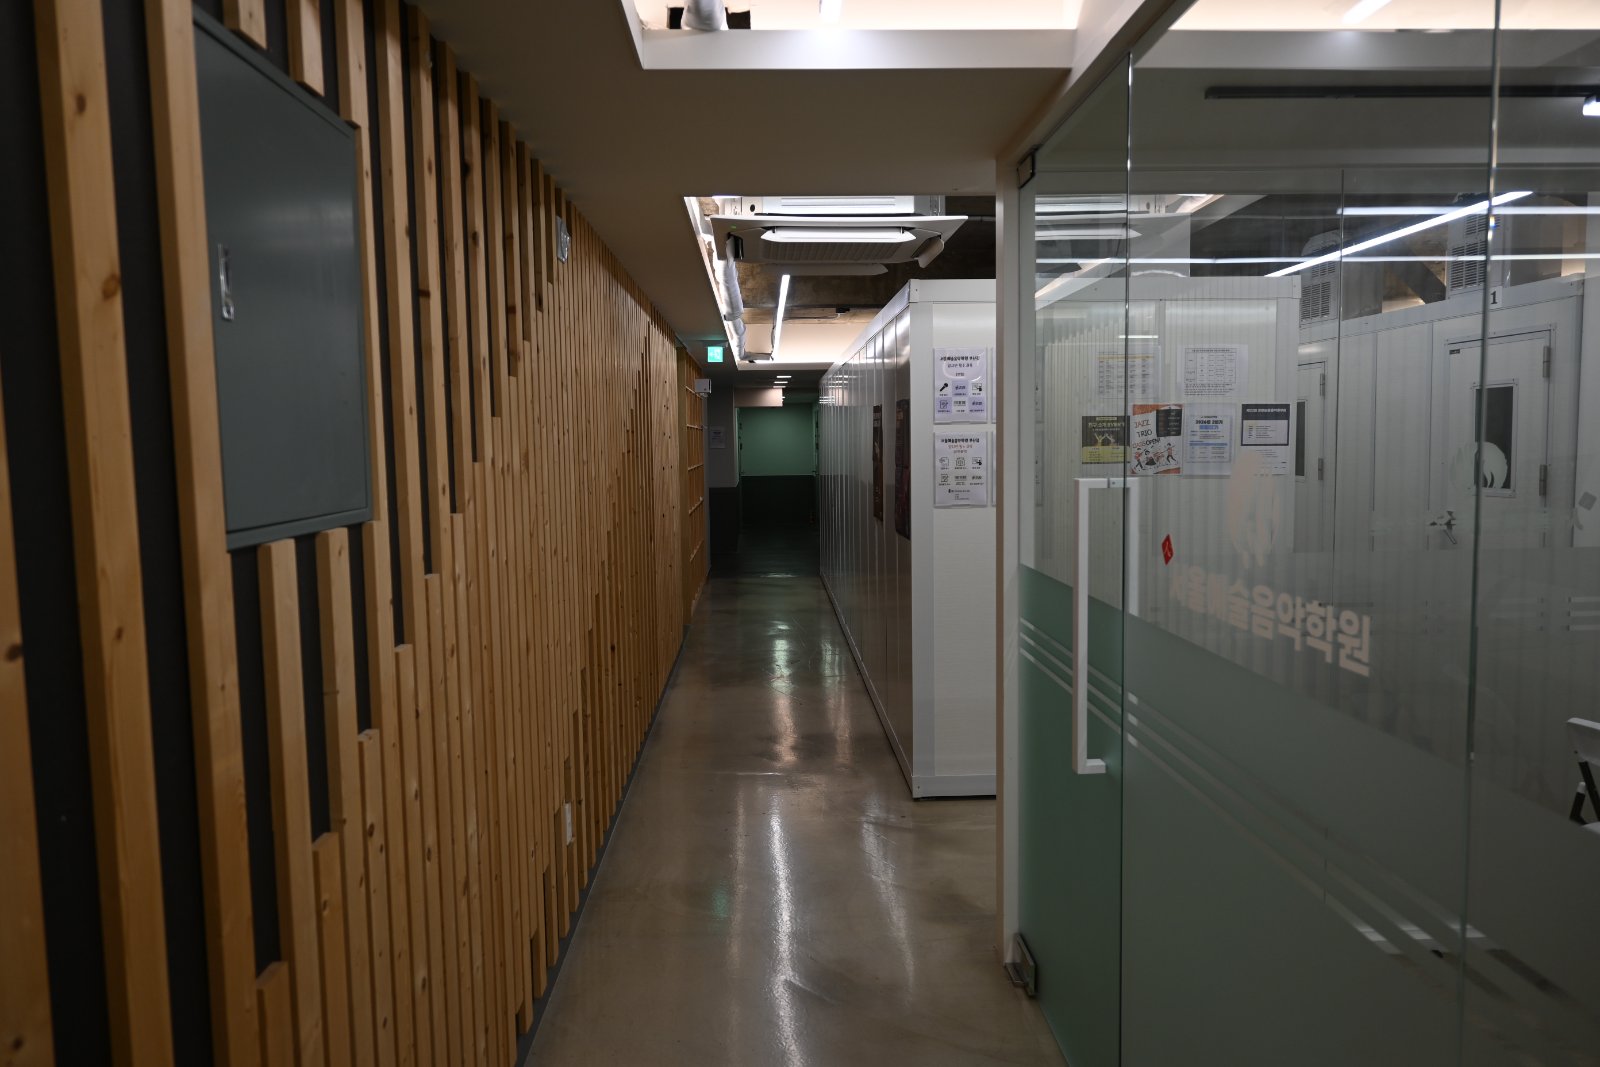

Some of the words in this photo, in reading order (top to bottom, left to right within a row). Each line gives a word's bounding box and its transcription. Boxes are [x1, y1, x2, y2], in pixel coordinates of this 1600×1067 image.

[1490, 291, 1498, 305] 1
[1134, 419, 1151, 429] JAZZ
[1136, 429, 1153, 438] TRIO
[1169, 564, 1371, 678] 서울예술음악학원
